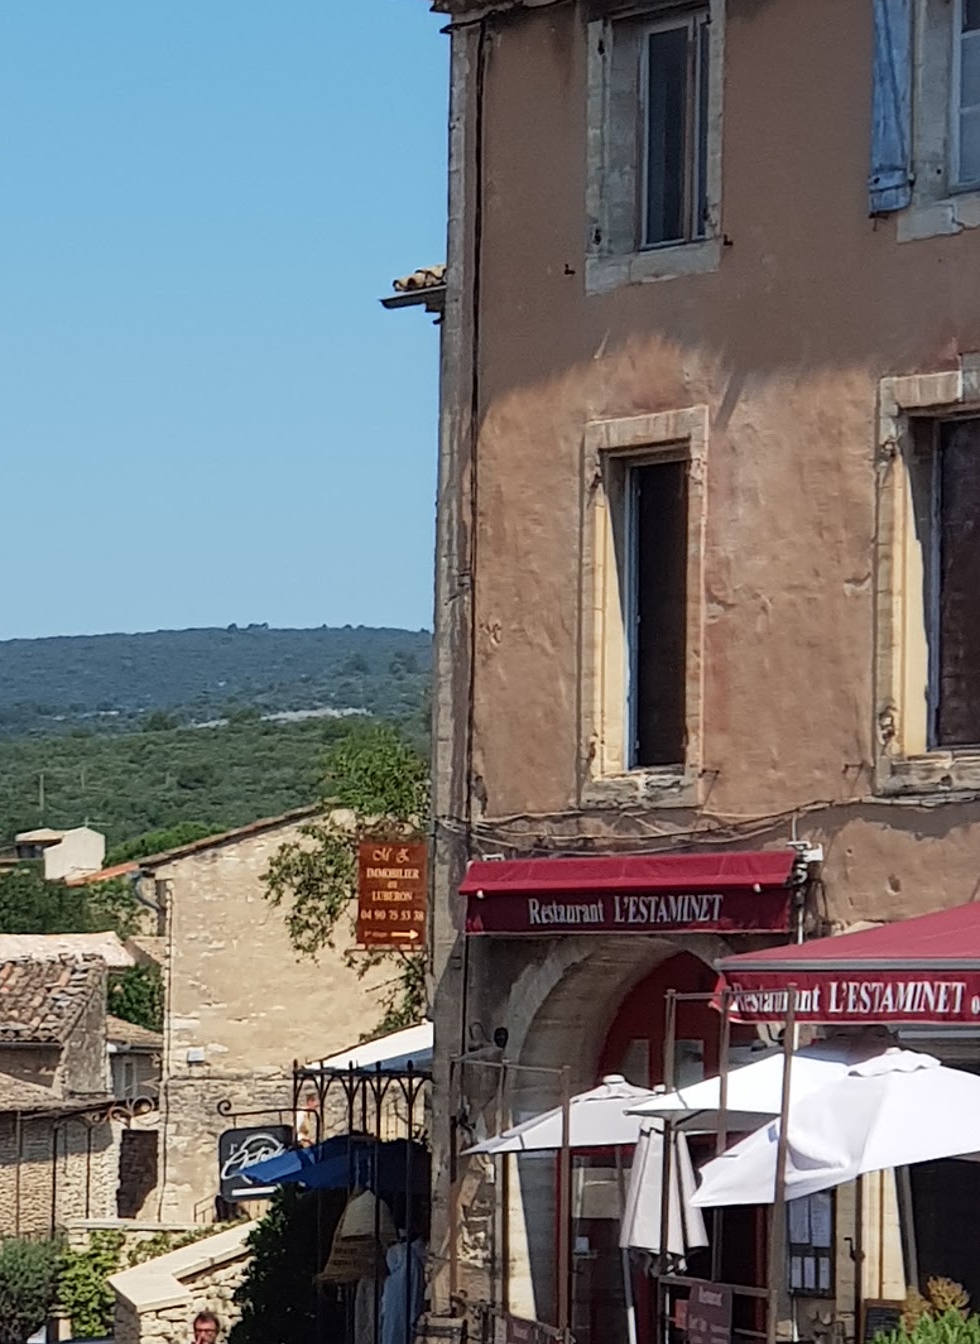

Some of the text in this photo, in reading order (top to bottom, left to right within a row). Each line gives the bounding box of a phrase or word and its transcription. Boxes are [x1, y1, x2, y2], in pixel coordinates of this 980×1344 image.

[360, 909, 372, 920] 04
[528, 894, 724, 925] Restaurant L'ESTAMINET
[729, 981, 821, 1013] Restauant
[828, 980, 967, 1014] L'ESTAMINET
